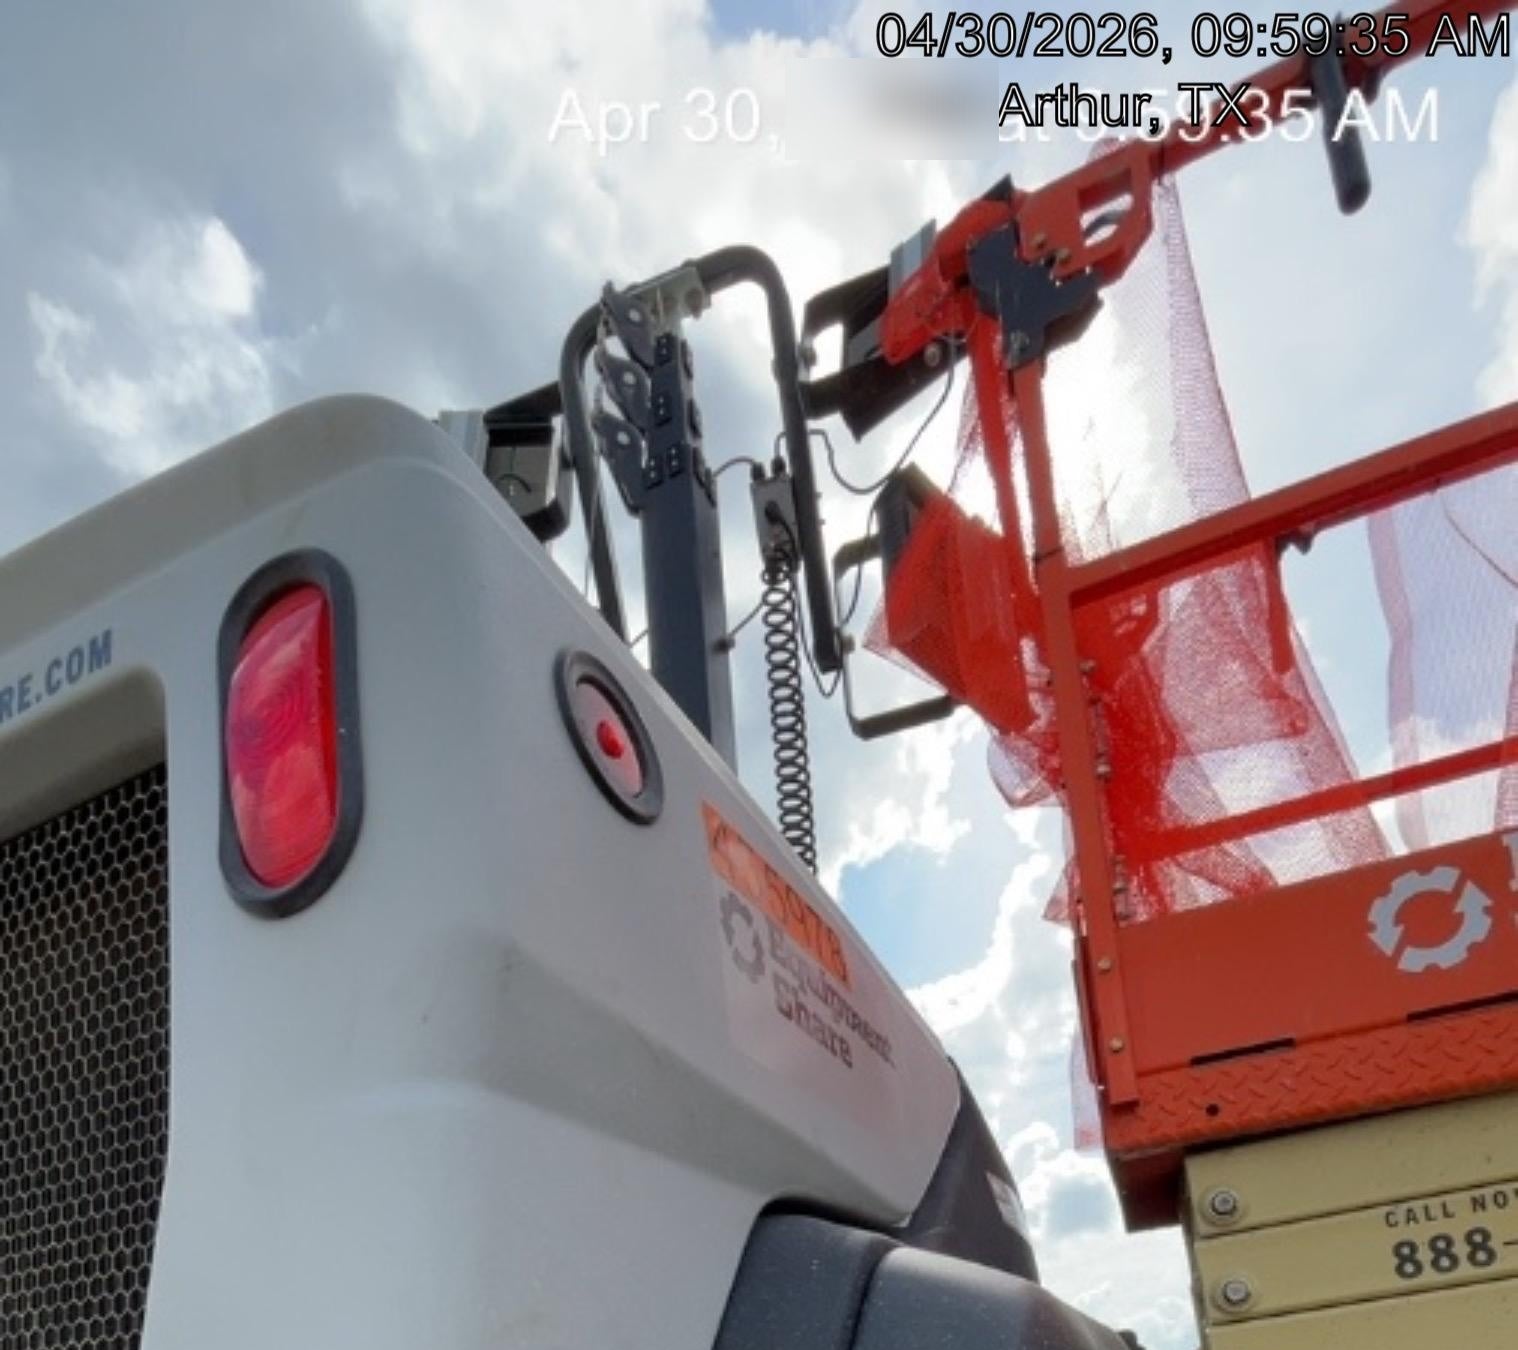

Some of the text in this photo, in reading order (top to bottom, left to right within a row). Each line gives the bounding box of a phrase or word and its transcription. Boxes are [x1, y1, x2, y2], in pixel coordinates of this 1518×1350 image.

[772, 971, 854, 1069] Share
[1384, 1187, 1518, 1228] CALL NO
[1391, 1225, 1518, 1280] 888-
